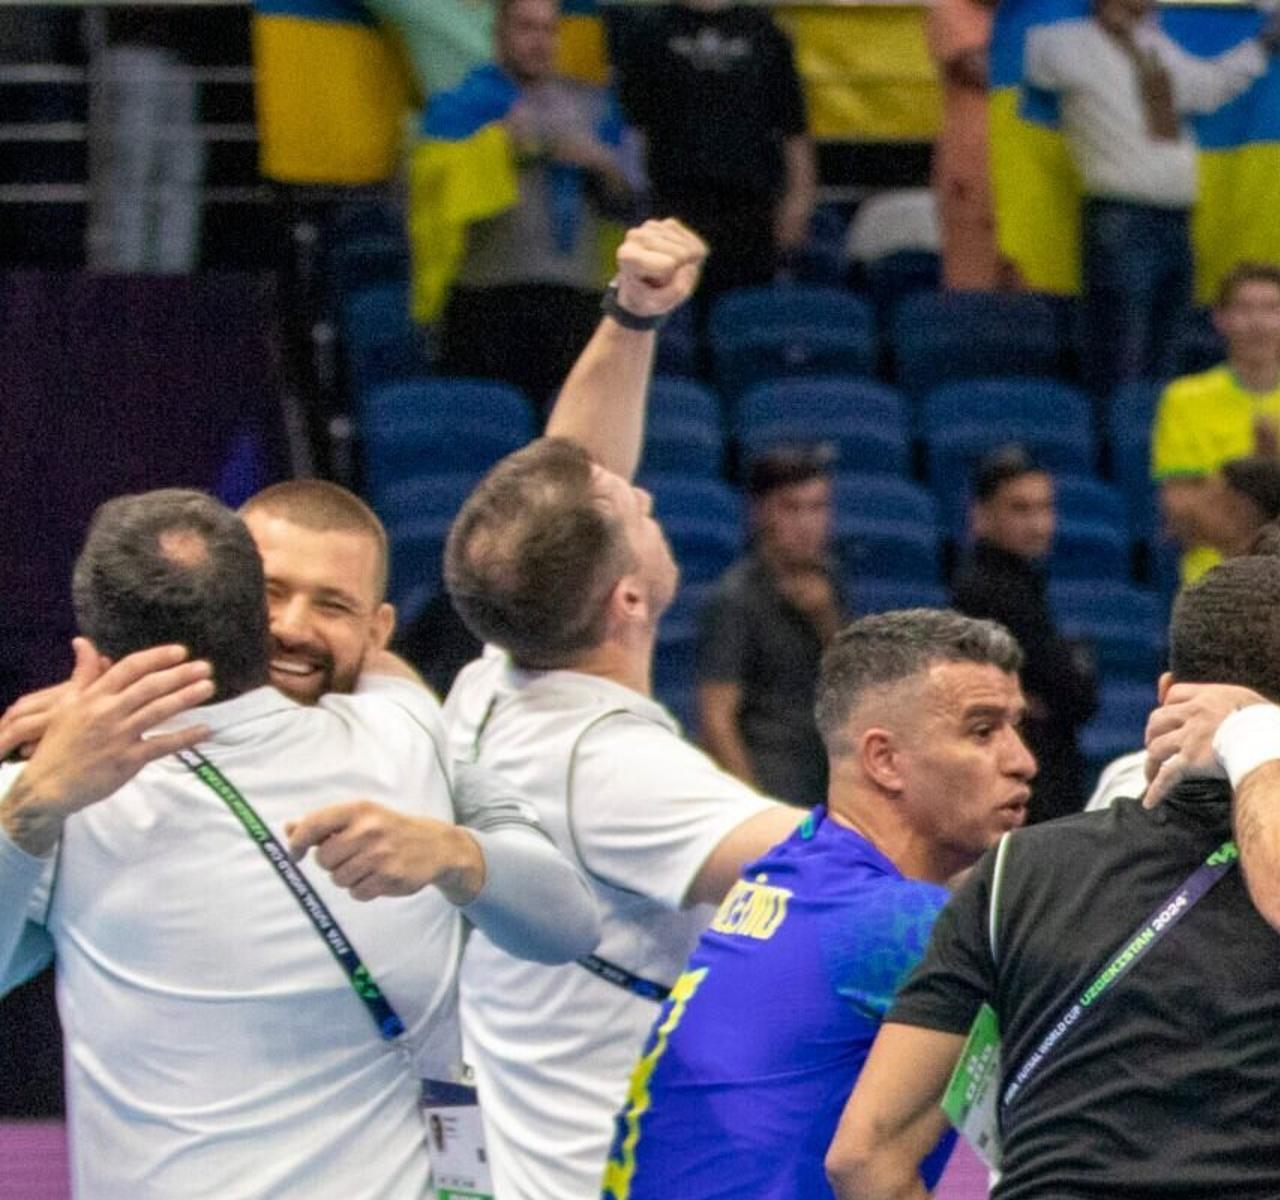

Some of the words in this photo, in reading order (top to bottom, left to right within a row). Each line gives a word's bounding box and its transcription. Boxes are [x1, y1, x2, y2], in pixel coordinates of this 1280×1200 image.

[1037, 1022, 1066, 1055] WORLD
[1063, 1004, 1082, 1027] CUP
[1079, 927, 1154, 1006] UZBEKISTAN
